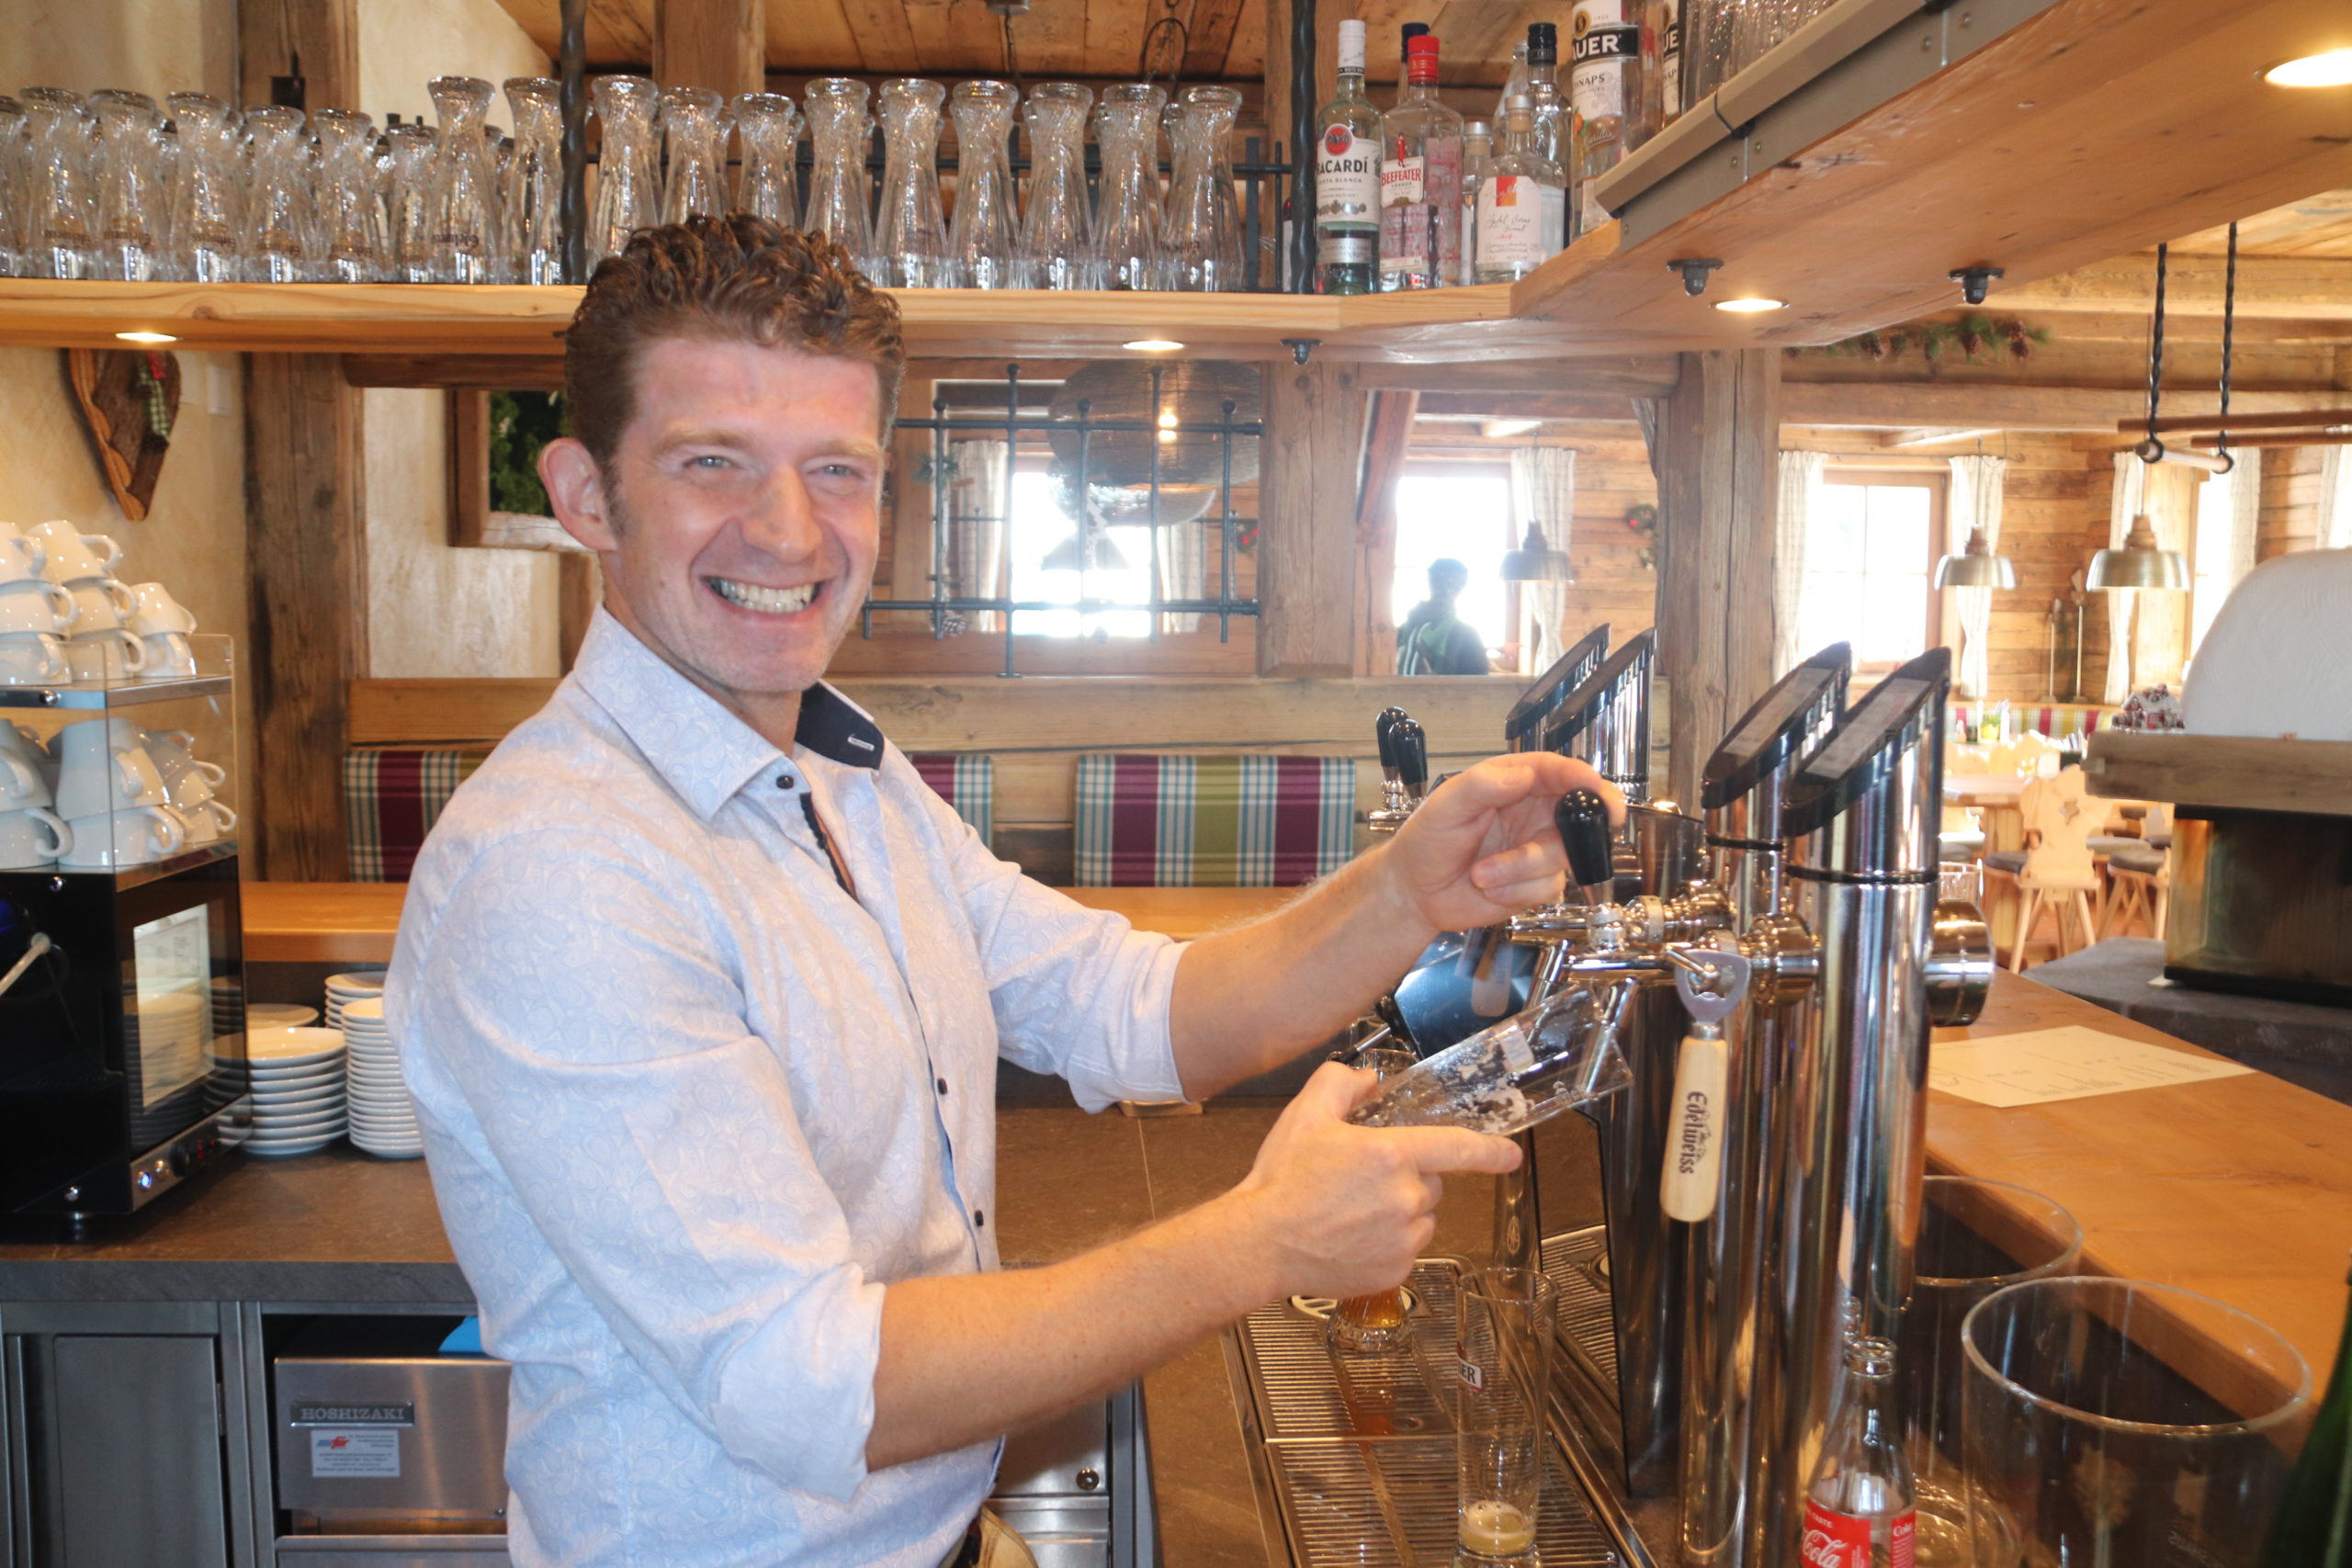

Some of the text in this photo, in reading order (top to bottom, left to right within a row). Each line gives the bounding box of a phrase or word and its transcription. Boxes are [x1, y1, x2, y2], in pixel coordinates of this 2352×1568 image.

[1381, 168, 1421, 186] BEEFEATER
[1679, 1091, 1707, 1174] Edelweiss
[300, 1408, 404, 1420] HOSHIZAKI
